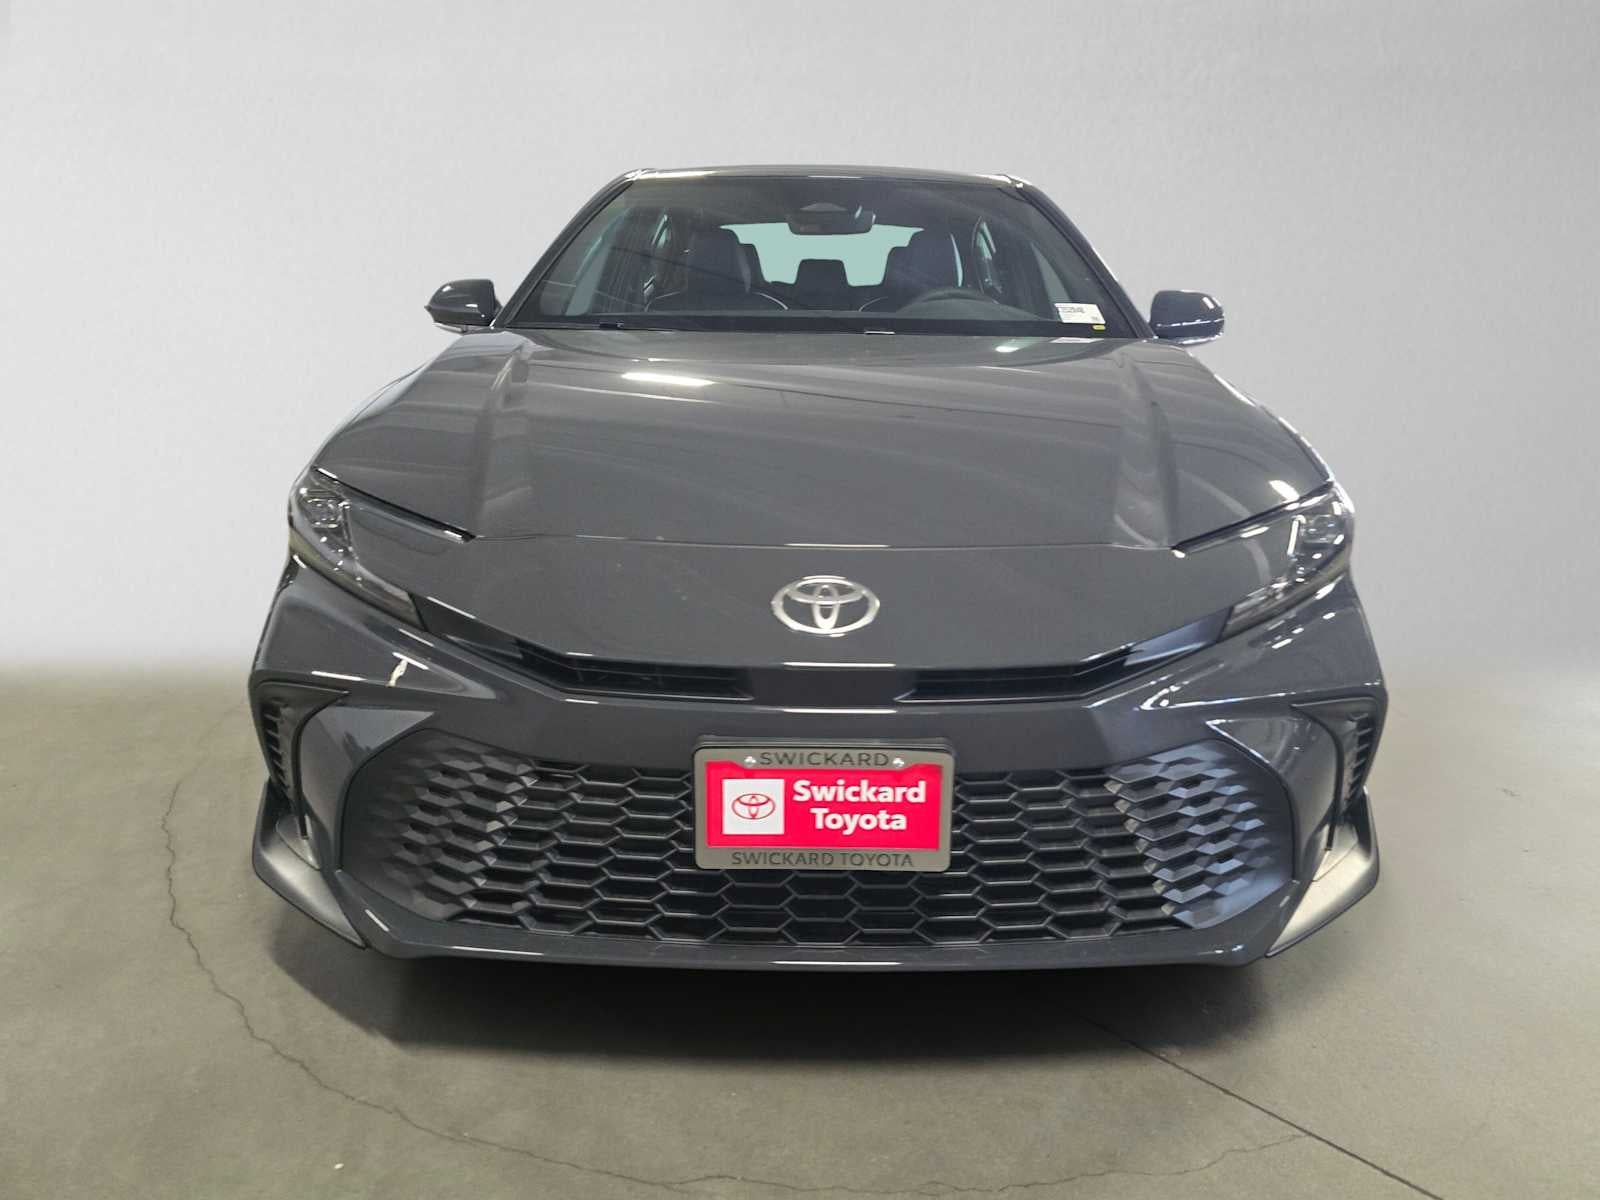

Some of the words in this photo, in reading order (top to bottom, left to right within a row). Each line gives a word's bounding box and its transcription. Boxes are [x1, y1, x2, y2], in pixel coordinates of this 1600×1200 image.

[760, 752, 889, 767] SWICKARD
[792, 780, 926, 803] Swickard
[810, 807, 907, 836] Toyota
[732, 851, 834, 866] SWICKARD
[840, 853, 913, 867] TOYOTA
